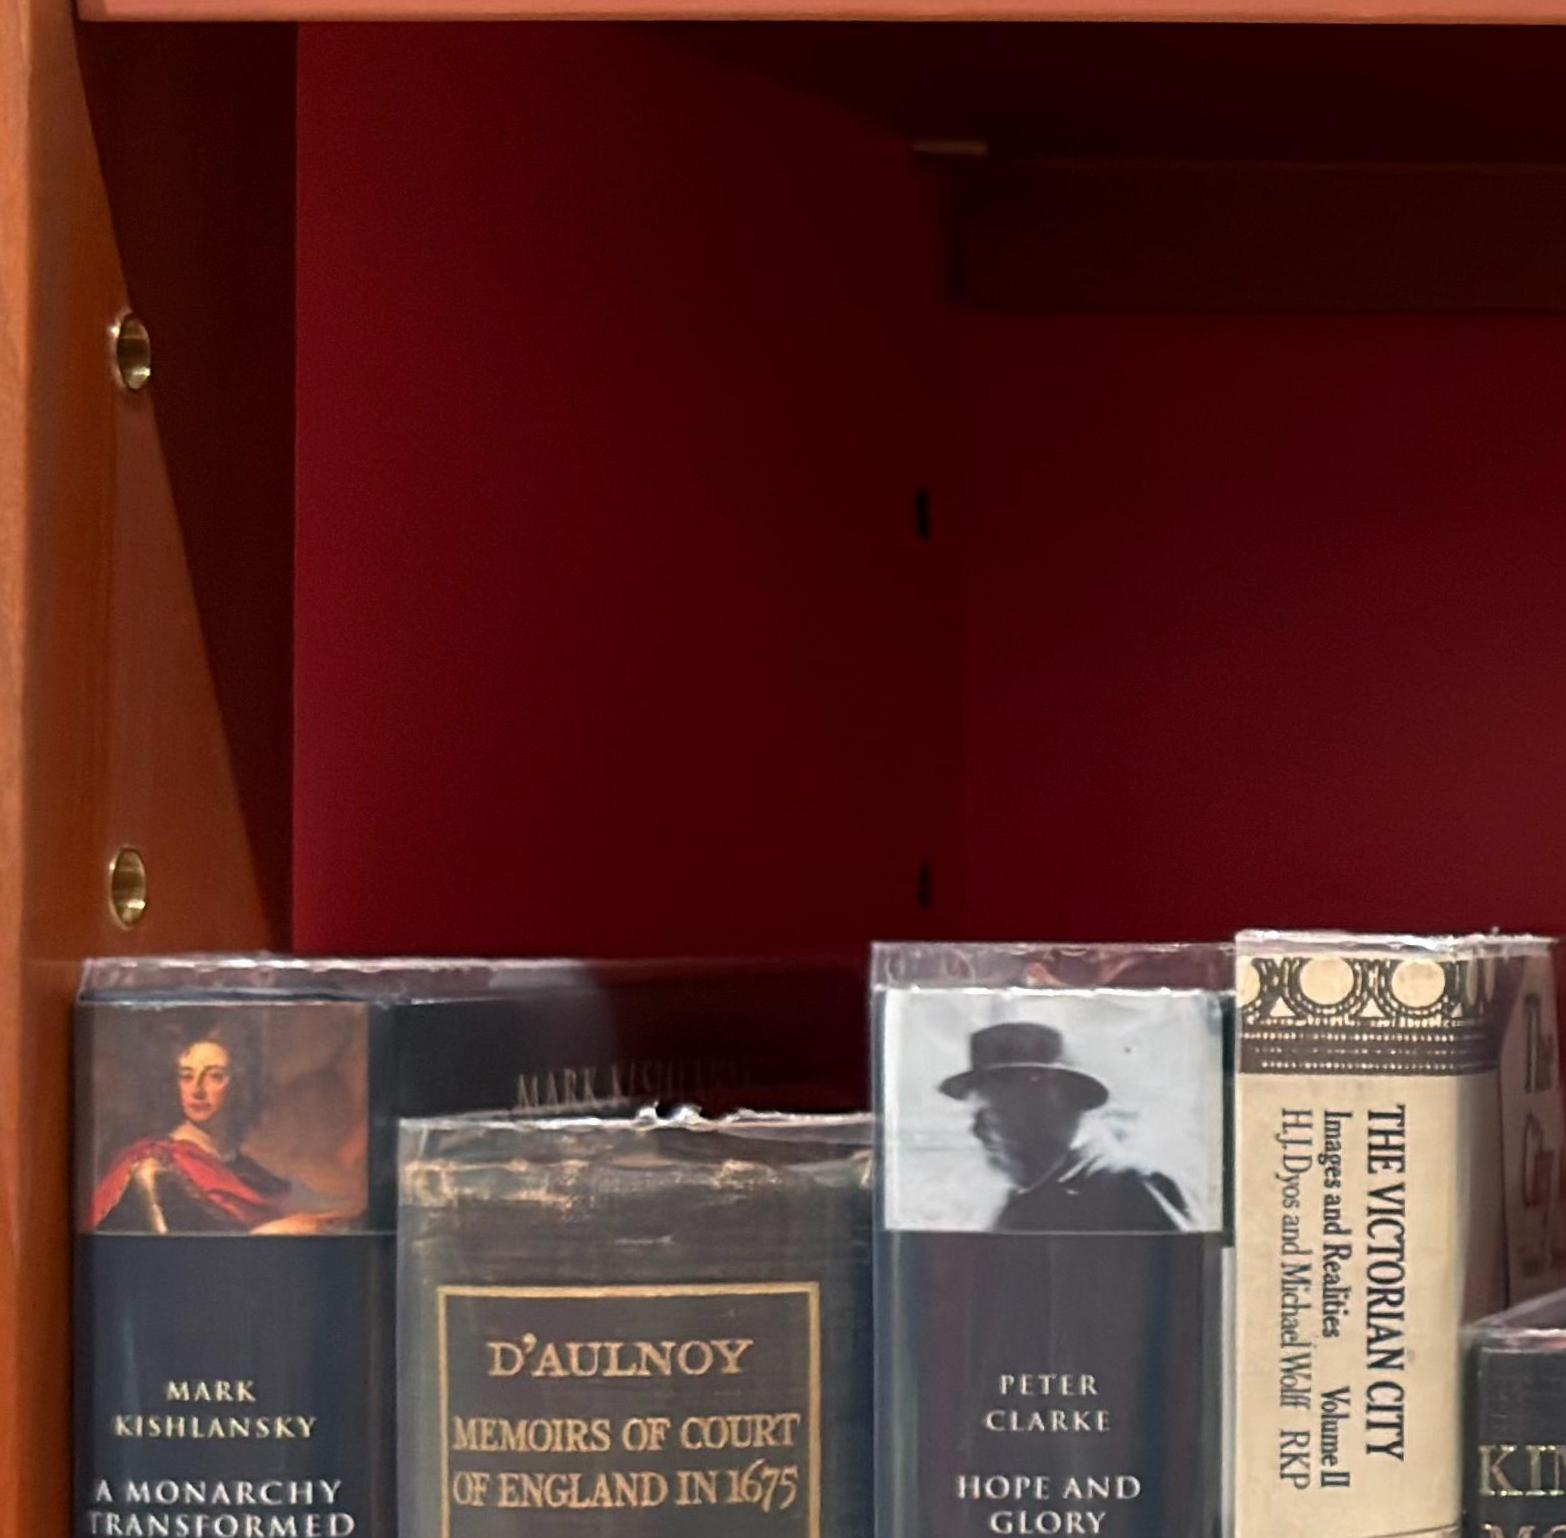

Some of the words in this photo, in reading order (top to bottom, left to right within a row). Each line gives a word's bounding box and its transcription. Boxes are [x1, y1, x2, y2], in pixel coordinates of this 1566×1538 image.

[1318, 1110, 1353, 1188] Images
[1367, 1104, 1406, 1174] THE
[1323, 1194, 1353, 1235] and
[1281, 1215, 1314, 1256] and
[1322, 1242, 1353, 1338] Realities
[1366, 1182, 1406, 1371] VICTORIAN
[1281, 1262, 1313, 1349] Michael
[488, 1333, 754, 1377] D'AULNOY
[167, 1380, 256, 1402] MARK
[1000, 1375, 1099, 1397] PETER
[1279, 1352, 1312, 1411] Wolff
[115, 1416, 317, 1439] KISHLANSKY
[453, 1416, 611, 1452] MEMOIRS
[623, 1417, 668, 1450] OF
[680, 1413, 801, 1449] COURT
[986, 1410, 1110, 1433] CLARKE
[1320, 1386, 1351, 1467] Volume
[1365, 1381, 1405, 1462] CITY
[1279, 1428, 1312, 1491] RKP
[1320, 1471, 1351, 1488] II
[95, 1481, 113, 1504] A
[125, 1480, 342, 1506] MONARCHY
[453, 1473, 487, 1507] OF
[495, 1472, 668, 1507] ENGLAND
[677, 1471, 722, 1505] IN
[728, 1460, 799, 1512] 1675
[957, 1476, 1051, 1500] HOPE
[1063, 1476, 1142, 1500] AND
[87, 1513, 355, 1538] TRANSFORMED
[989, 1511, 1106, 1535] GLORY
